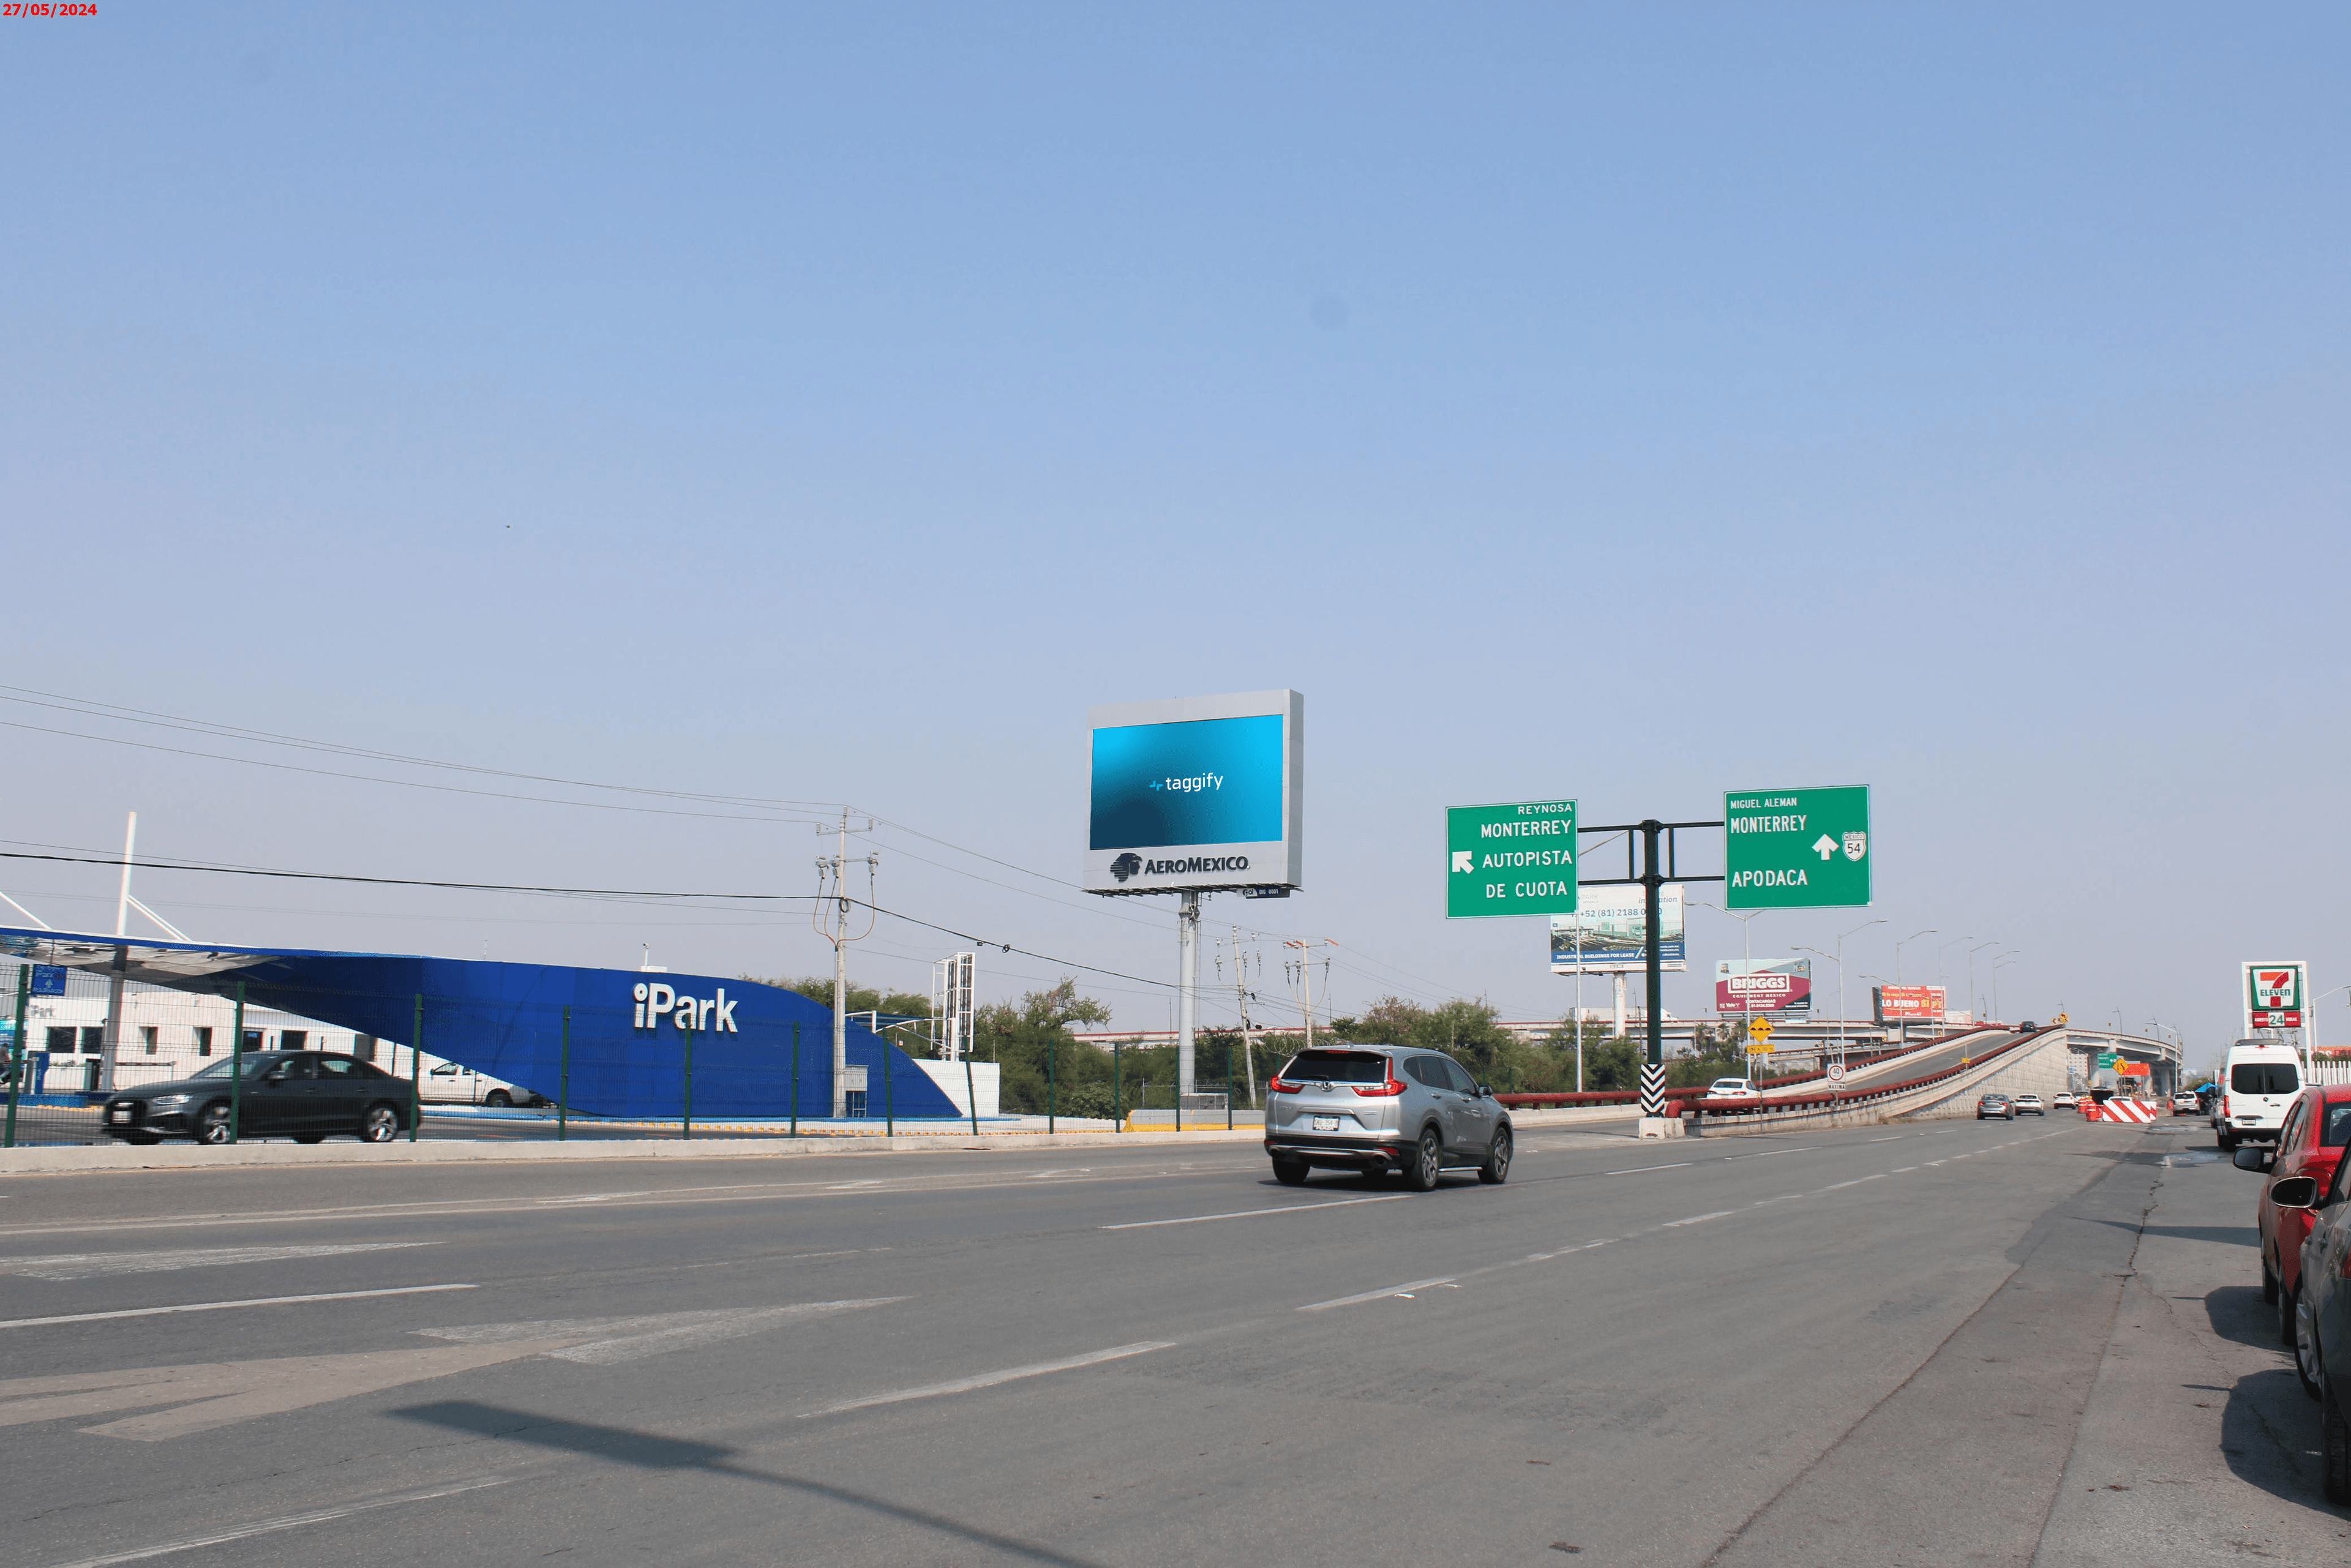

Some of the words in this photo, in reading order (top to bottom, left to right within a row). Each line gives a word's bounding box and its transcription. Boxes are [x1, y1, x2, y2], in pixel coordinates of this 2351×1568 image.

[1166, 772, 1223, 792] taggify
[1518, 803, 1572, 814] REYNOSA
[1730, 799, 1761, 809] MIGUEL
[1764, 797, 1798, 808] ALEMAN
[1481, 819, 1572, 838] MONTERREY
[1730, 814, 1807, 834] MONTERREY
[1847, 842, 1861, 854] 54
[1144, 856, 1250, 874] AEROMEXICO
[1482, 850, 1572, 868] AUTOPISTA
[1731, 869, 1809, 888] APODACA
[1486, 883, 1505, 898] DE
[1515, 880, 1567, 897] CUOTA
[1598, 909, 1614, 918] (81)
[1732, 977, 1785, 989] BRIGGS
[634, 983, 738, 1033] iPark
[2269, 1015, 2284, 1025] 24
